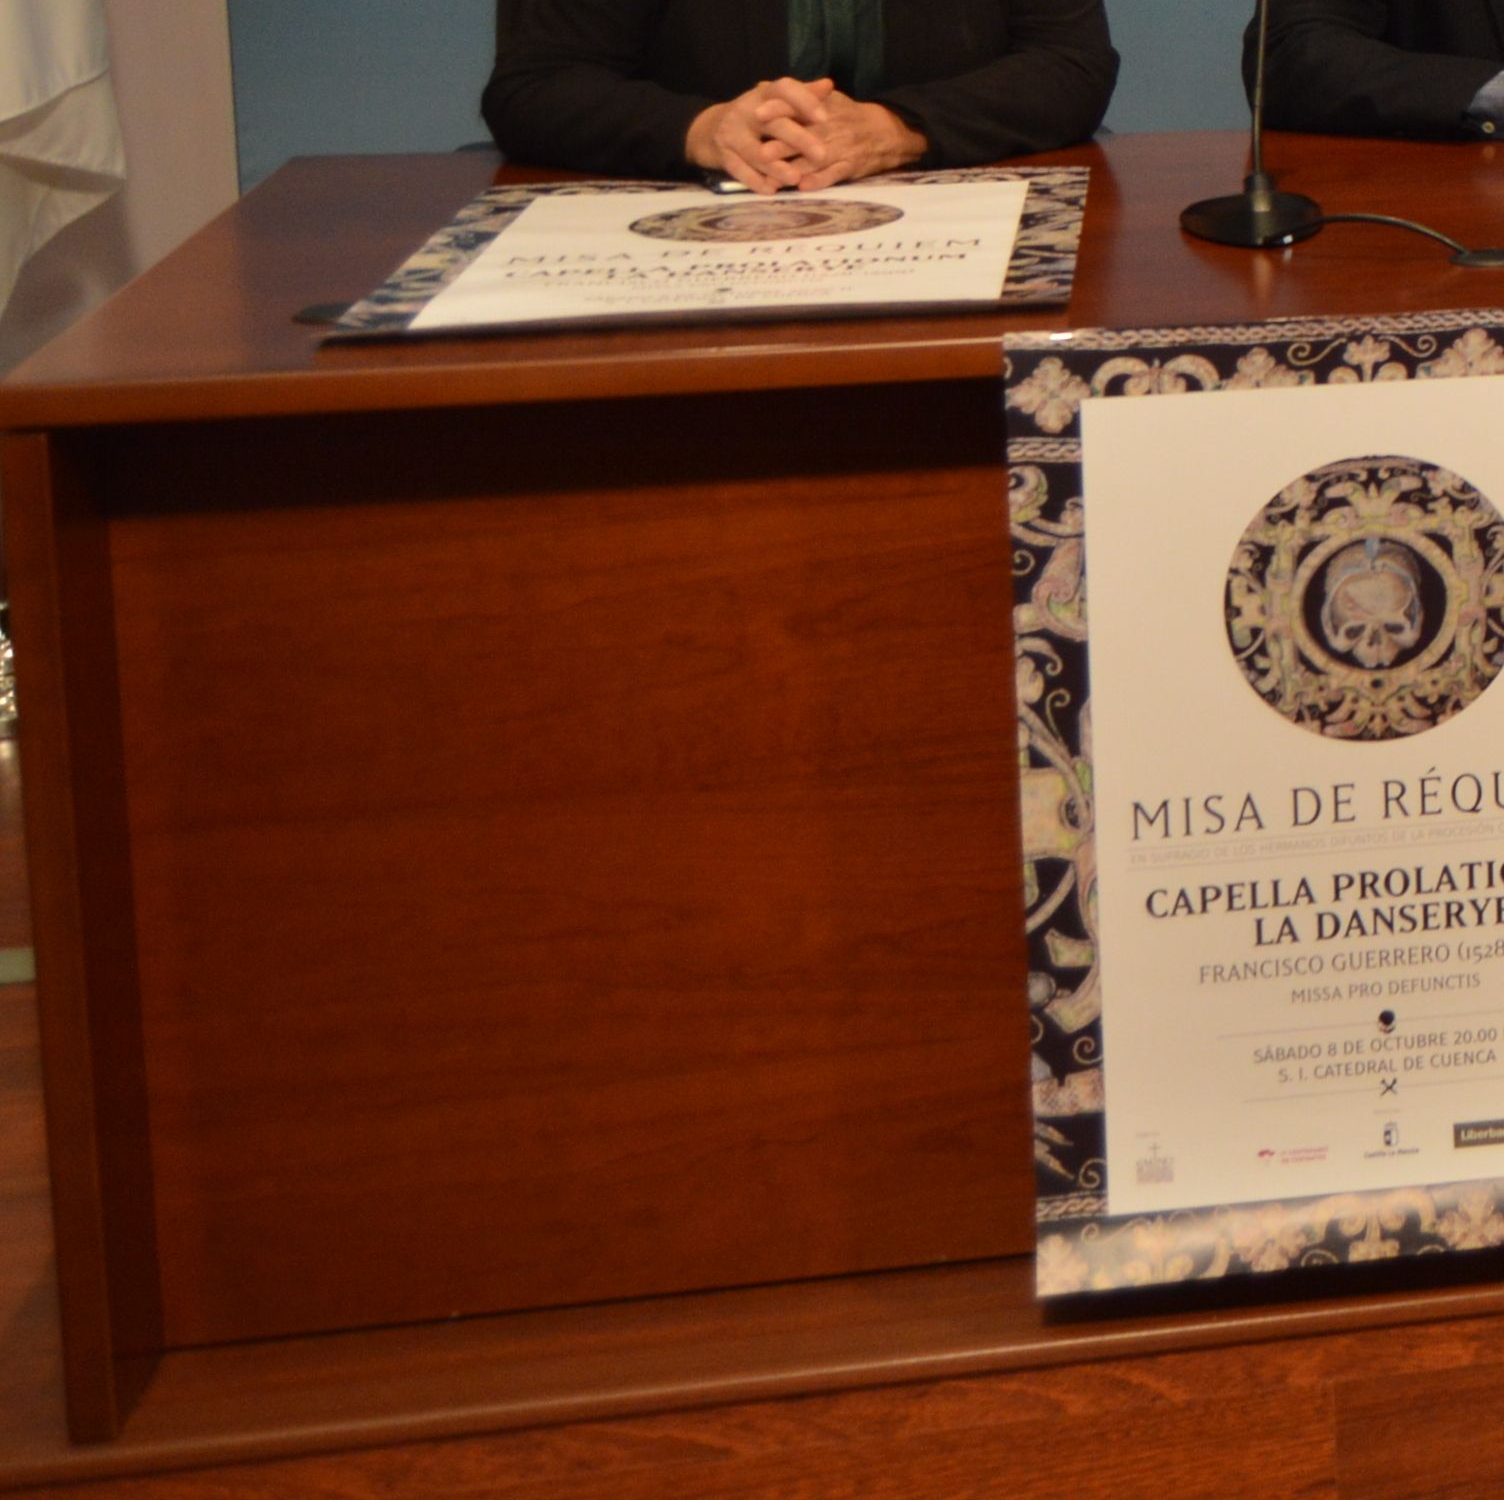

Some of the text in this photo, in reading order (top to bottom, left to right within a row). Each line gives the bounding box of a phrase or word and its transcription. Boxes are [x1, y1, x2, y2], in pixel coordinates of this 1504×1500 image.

[1131, 791, 1267, 841] MISA
[1291, 782, 1357, 828] DE
[1145, 876, 1317, 920] CAPELLA
[1253, 912, 1301, 947] LA
[1199, 954, 1325, 985] FRANCISCO
[1331, 942, 1451, 974] GUERRERO
[1290, 972, 1482, 1004] MISSA PRO DEFUNCTIS
[1253, 1040, 1323, 1064] SÁBADO
[1327, 1042, 1338, 1057] 8
[1343, 1039, 1365, 1056] DE
[1369, 1030, 1449, 1054] OCTUBRE
[1453, 1027, 1498, 1046] 20.00
[1278, 1066, 1293, 1084] S.
[1313, 1057, 1398, 1080] CATEDRAL
[1402, 1054, 1424, 1071] DE
[1430, 1048, 1498, 1069] CUENCA
